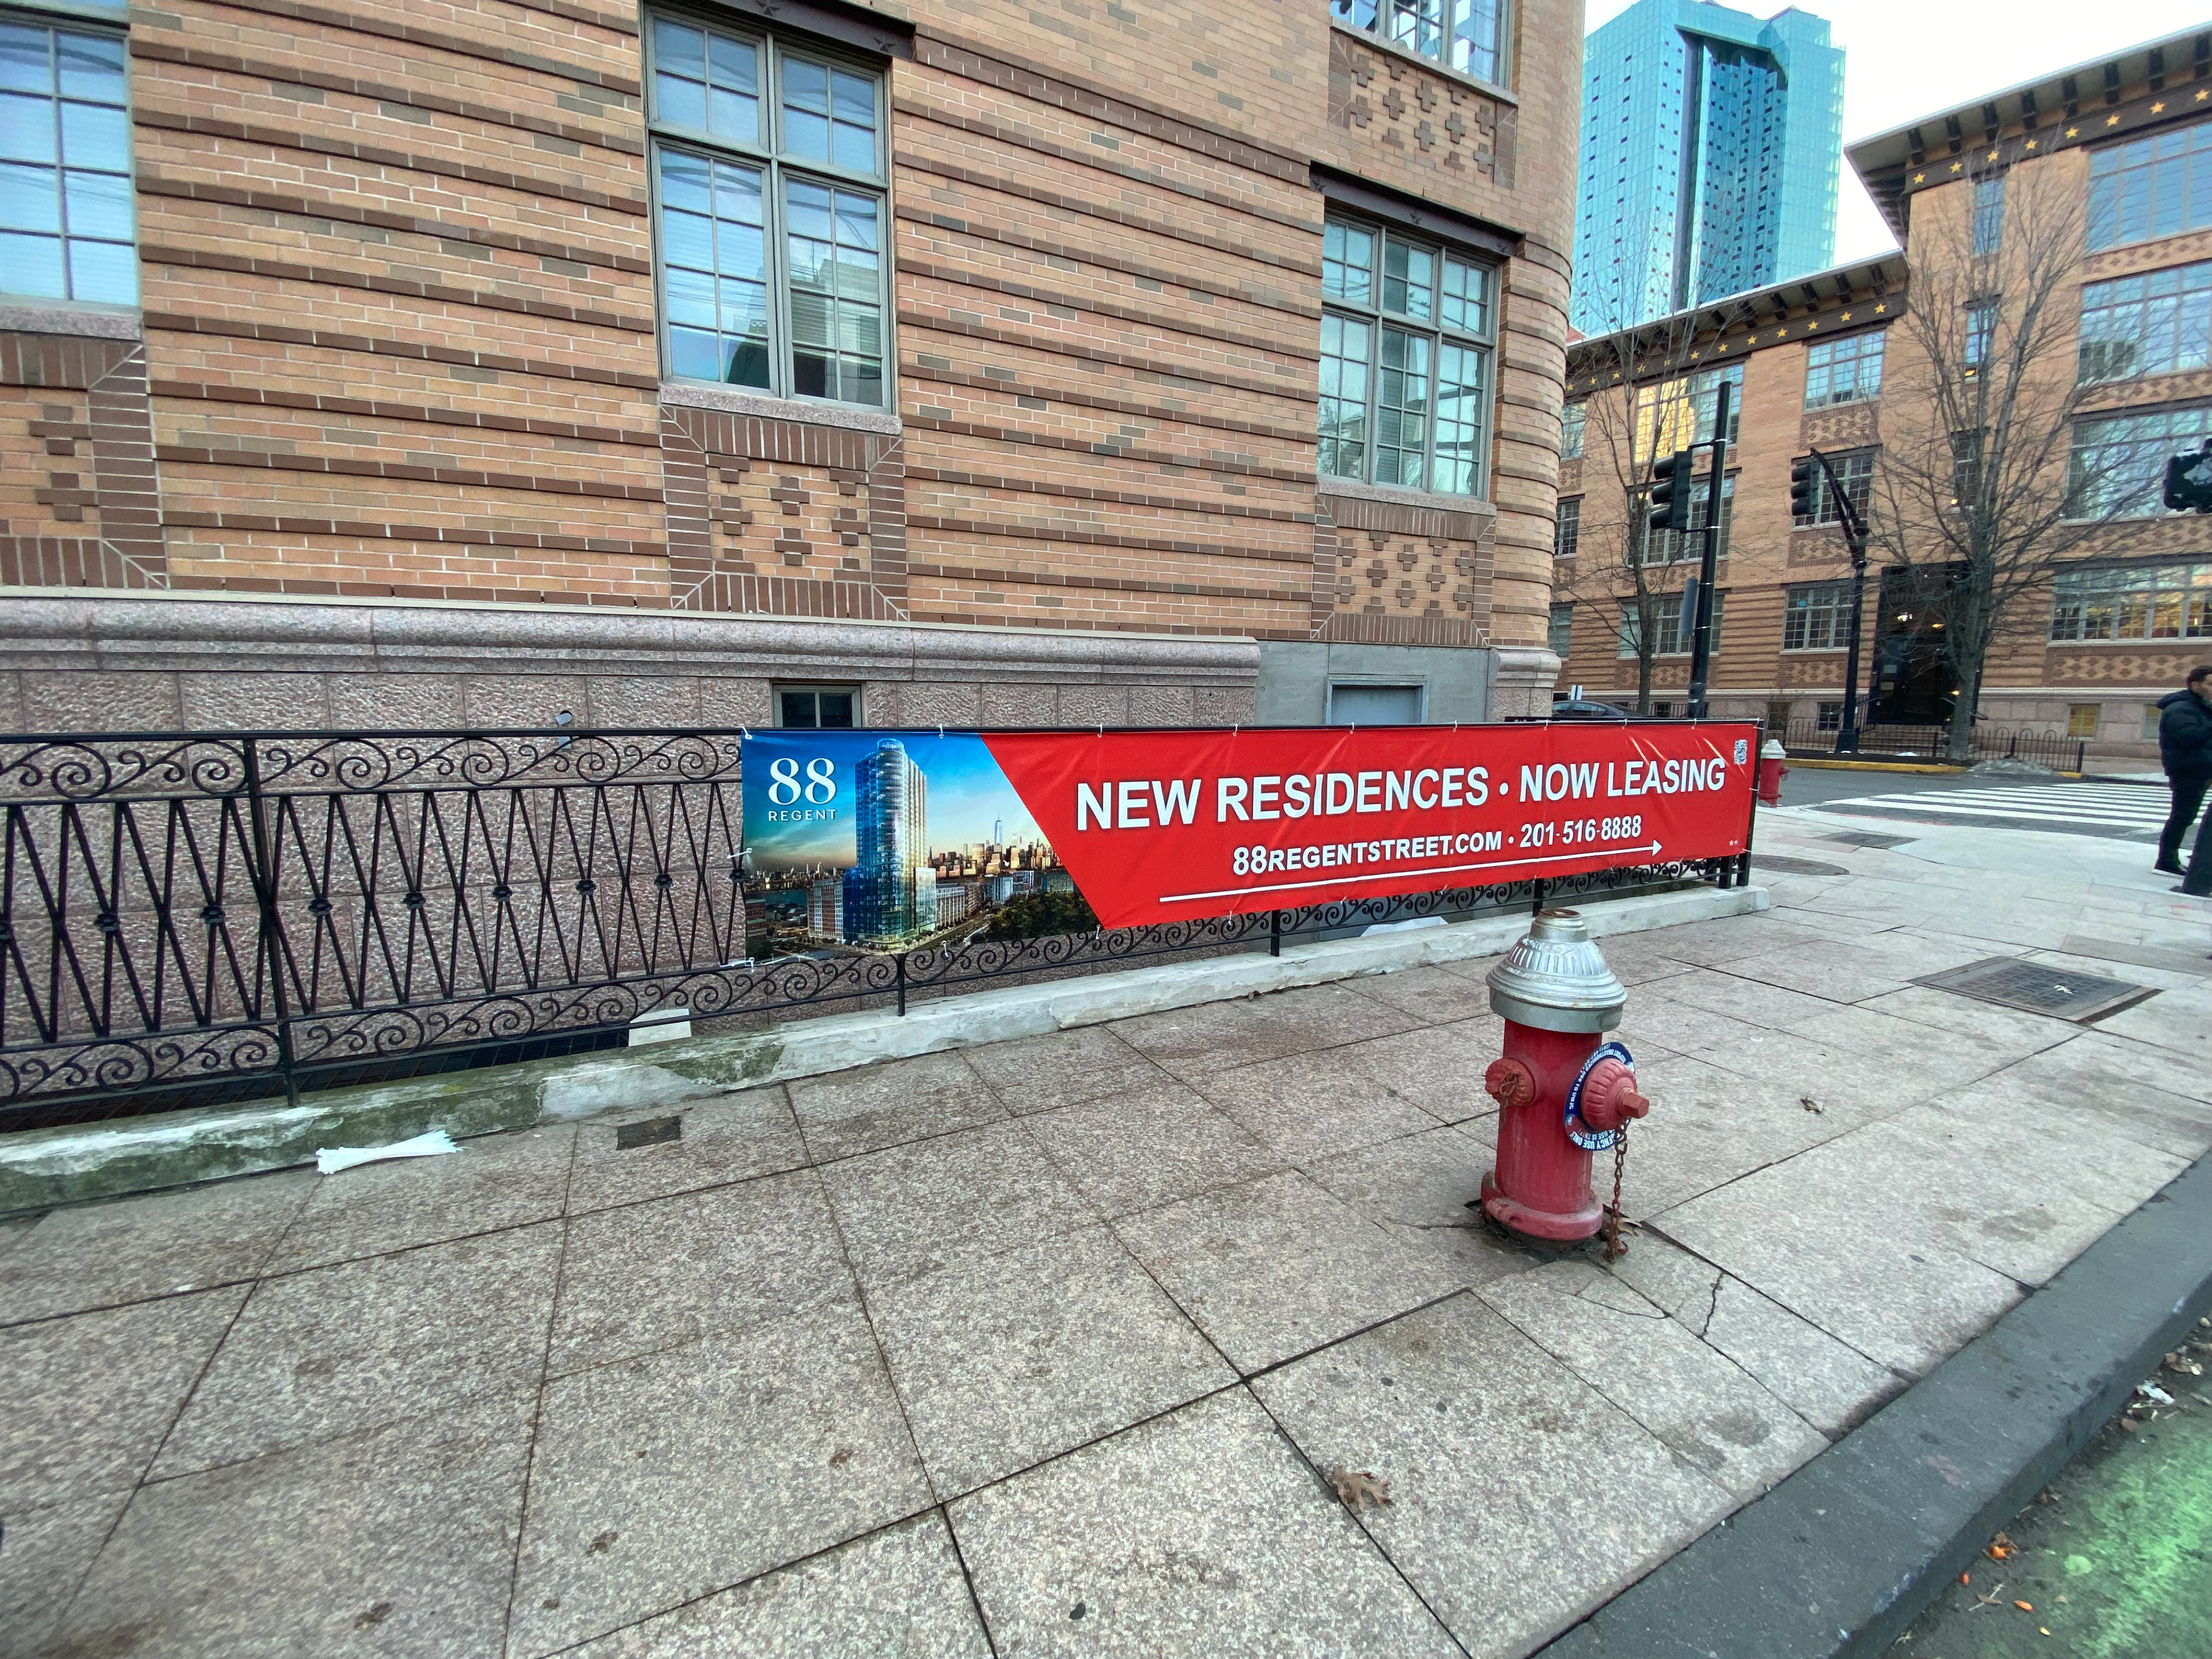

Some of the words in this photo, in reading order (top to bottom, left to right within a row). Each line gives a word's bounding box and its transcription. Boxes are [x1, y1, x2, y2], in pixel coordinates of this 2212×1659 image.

[768, 757, 836, 805] 88
[1077, 779, 1202, 831] NEW
[1217, 767, 1488, 823] RESIDENCES
[1519, 762, 1600, 802] NOW
[1607, 757, 1726, 797] LEASING
[768, 808, 837, 822] REGENT
[1233, 831, 1502, 876] 88REGENTSTREET.COM
[1520, 815, 1642, 848] 201-516-8888
[1570, 1131, 1582, 1145] ONLY
[1598, 1131, 1609, 1140] USE
[1582, 1138, 1595, 1149] USE
